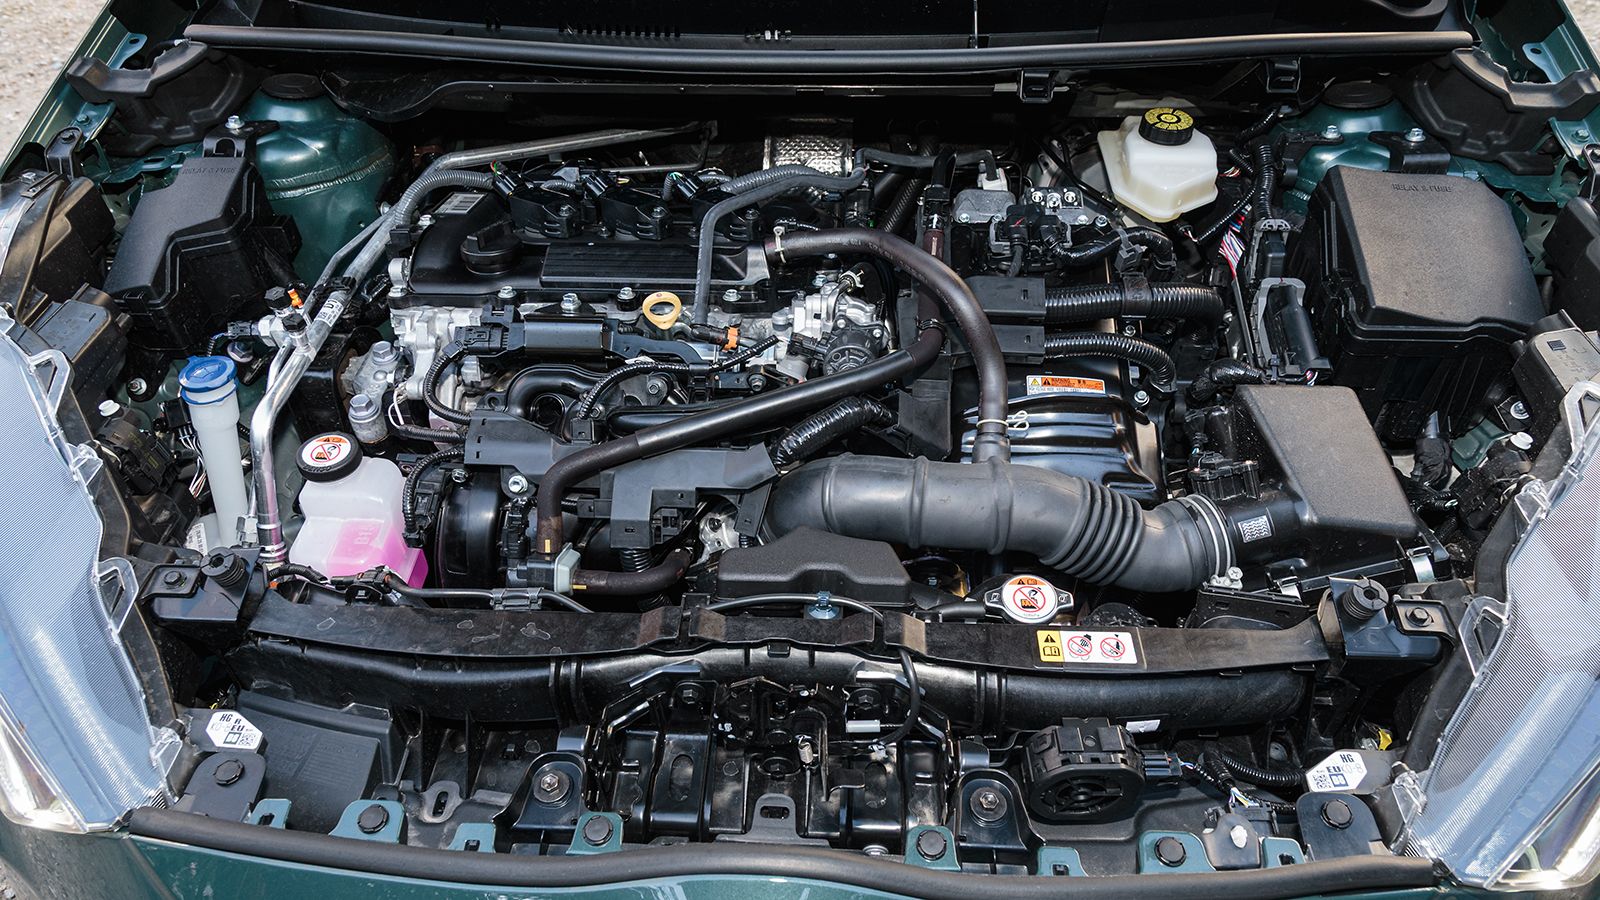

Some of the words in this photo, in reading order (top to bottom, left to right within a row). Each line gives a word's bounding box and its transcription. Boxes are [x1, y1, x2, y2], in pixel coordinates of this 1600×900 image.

[1391, 183, 1419, 192] RELAY
[1429, 184, 1454, 193] FUSE
[219, 713, 233, 722] HG
[231, 724, 245, 732] EU
[1339, 753, 1355, 764] HG
[1326, 765, 1341, 774] EU
